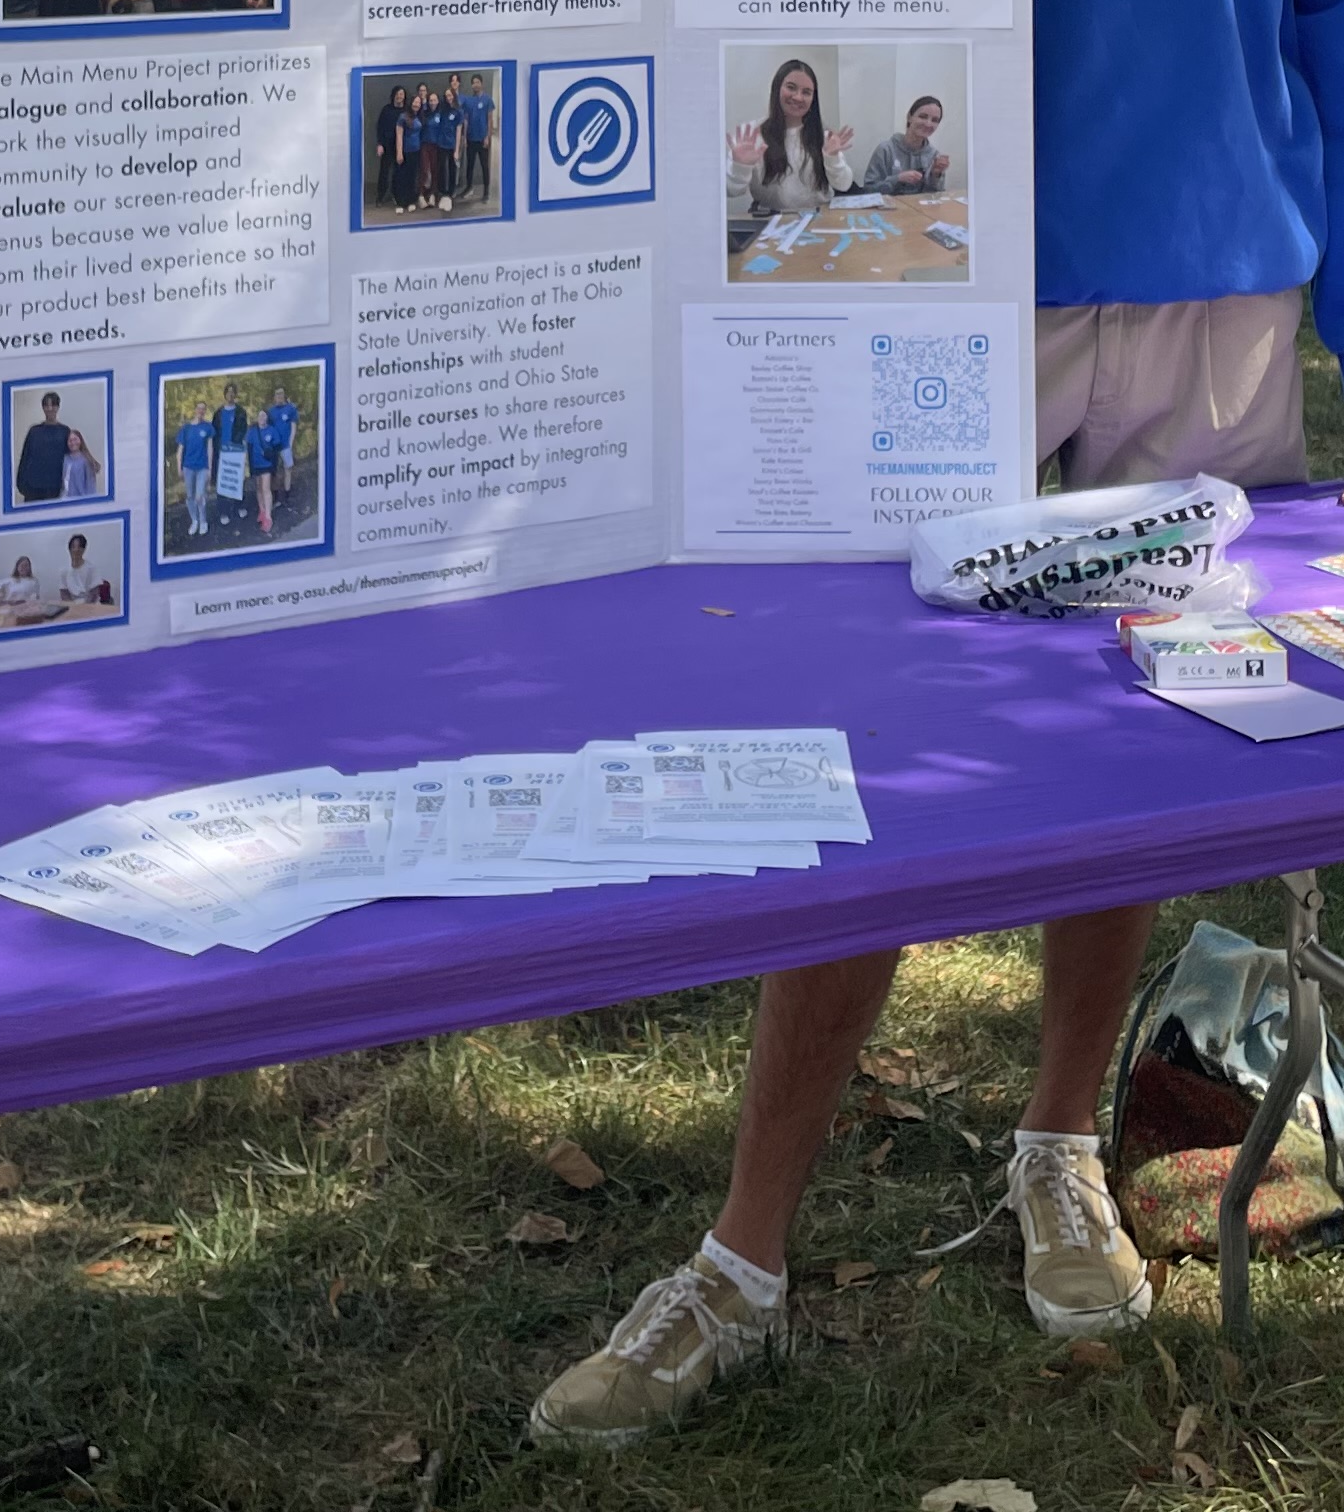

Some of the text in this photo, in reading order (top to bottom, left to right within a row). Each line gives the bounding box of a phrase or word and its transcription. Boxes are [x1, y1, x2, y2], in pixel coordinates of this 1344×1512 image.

[21, 66, 74, 86] Main
[82, 63, 138, 83] Menu
[146, 59, 211, 83] Project
[218, 55, 312, 79] prioritizes
[75, 92, 113, 116] and
[121, 87, 254, 113] collaboration.
[262, 84, 297, 103] We
[36, 129, 66, 151] the
[74, 122, 148, 150] visually
[156, 116, 242, 142] impaired
[95, 162, 113, 180] to
[121, 153, 199, 178] develop
[205, 147, 242, 171] and
[358, 255, 642, 297] The Main Menu Project is a student
[358, 280, 623, 324] service organization at The Ohio
[358, 313, 576, 351] State University. We foster
[726, 330, 836, 348] Our Partners
[358, 340, 565, 379] relationships with student
[866, 462, 997, 476] THEMAINMENUPROJECT
[871, 487, 993, 504] FOLLOW OUR
[1134, 500, 1219, 537] and
[195, 600, 232, 617] Learn
